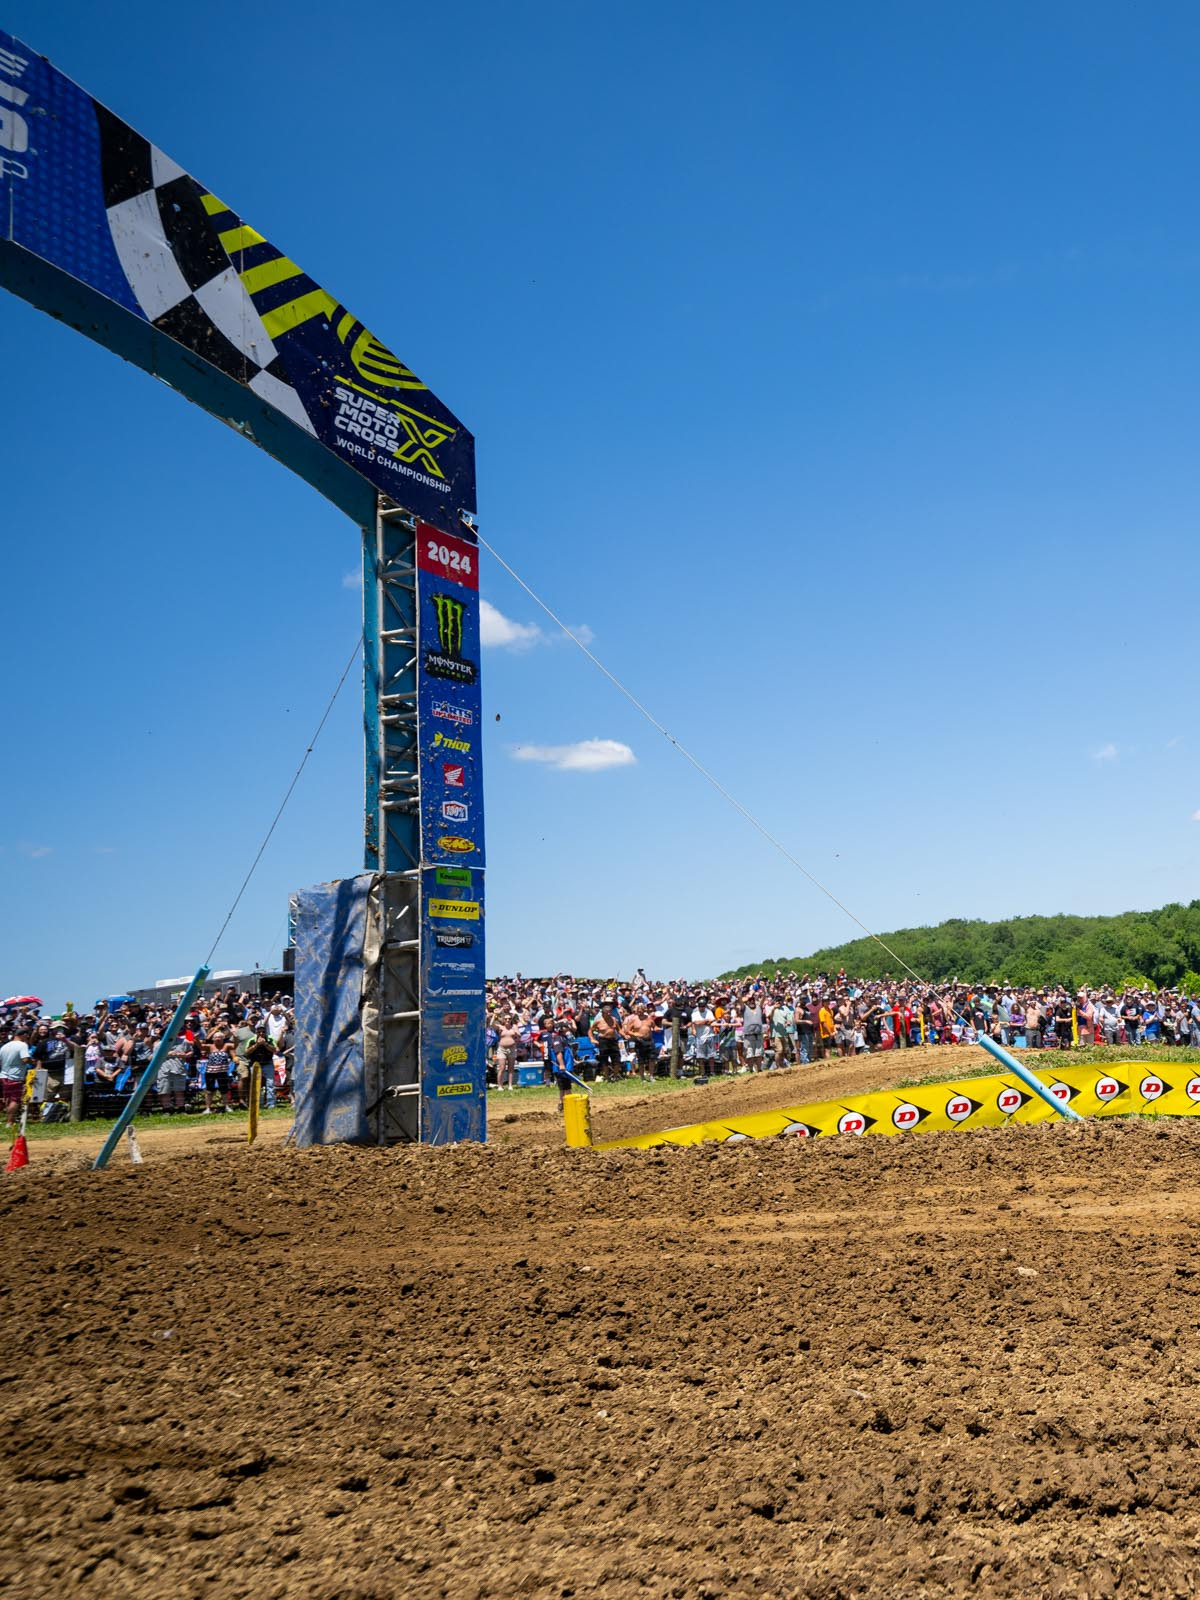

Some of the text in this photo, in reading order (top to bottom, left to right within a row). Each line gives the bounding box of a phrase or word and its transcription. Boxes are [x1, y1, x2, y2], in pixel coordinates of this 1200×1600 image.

[334, 387, 400, 428] SUPER
[339, 403, 398, 439] MOTO
[334, 415, 400, 453] CROSS
[336, 437, 451, 493] WORLD CHAMPIONSHIP
[427, 541, 472, 575] 2024
[428, 655, 473, 674] MONSTER
[443, 738, 471, 752] THOR
[438, 904, 477, 913] DUNLOP
[437, 935, 465, 944] TRIUMPH
[843, 1119, 862, 1131] D
[896, 1111, 916, 1123] D
[949, 1102, 969, 1113] D
[1001, 1095, 1019, 1107] D
[1100, 1083, 1116, 1095] D
[1143, 1082, 1160, 1093] D
